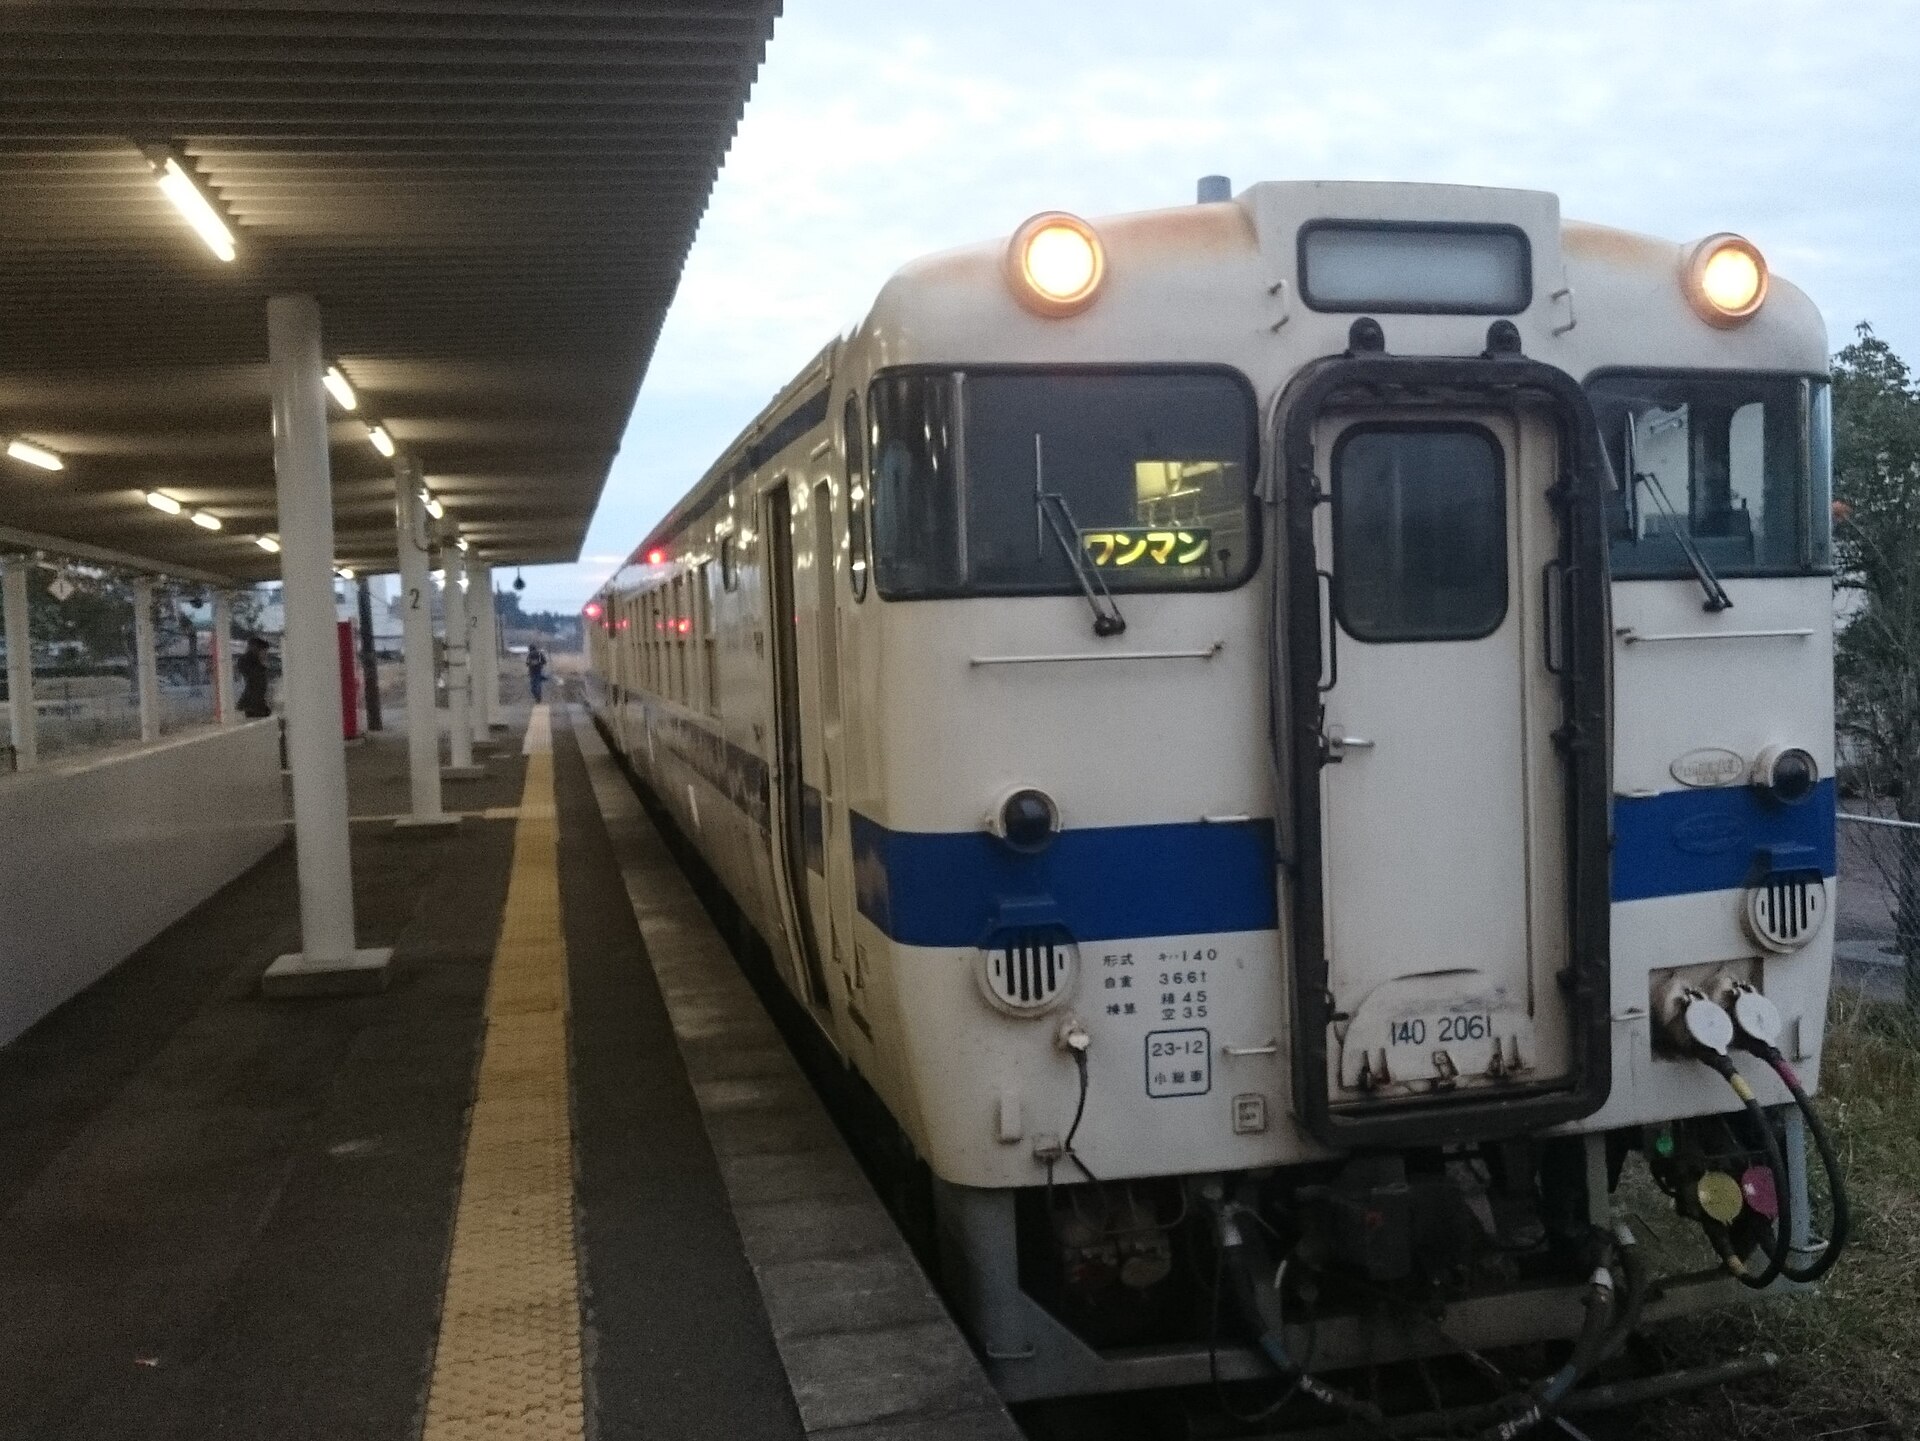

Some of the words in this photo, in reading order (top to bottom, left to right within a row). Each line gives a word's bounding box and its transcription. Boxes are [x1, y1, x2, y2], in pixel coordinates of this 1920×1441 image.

[1083, 532, 1208, 565] ワンマン
[410, 588, 420, 609] 2
[1103, 953, 1134, 967] 形式
[1391, 1018, 1426, 1046] 140
[1438, 1014, 1491, 1042] 2061
[1152, 1040, 1204, 1056] 23-12
